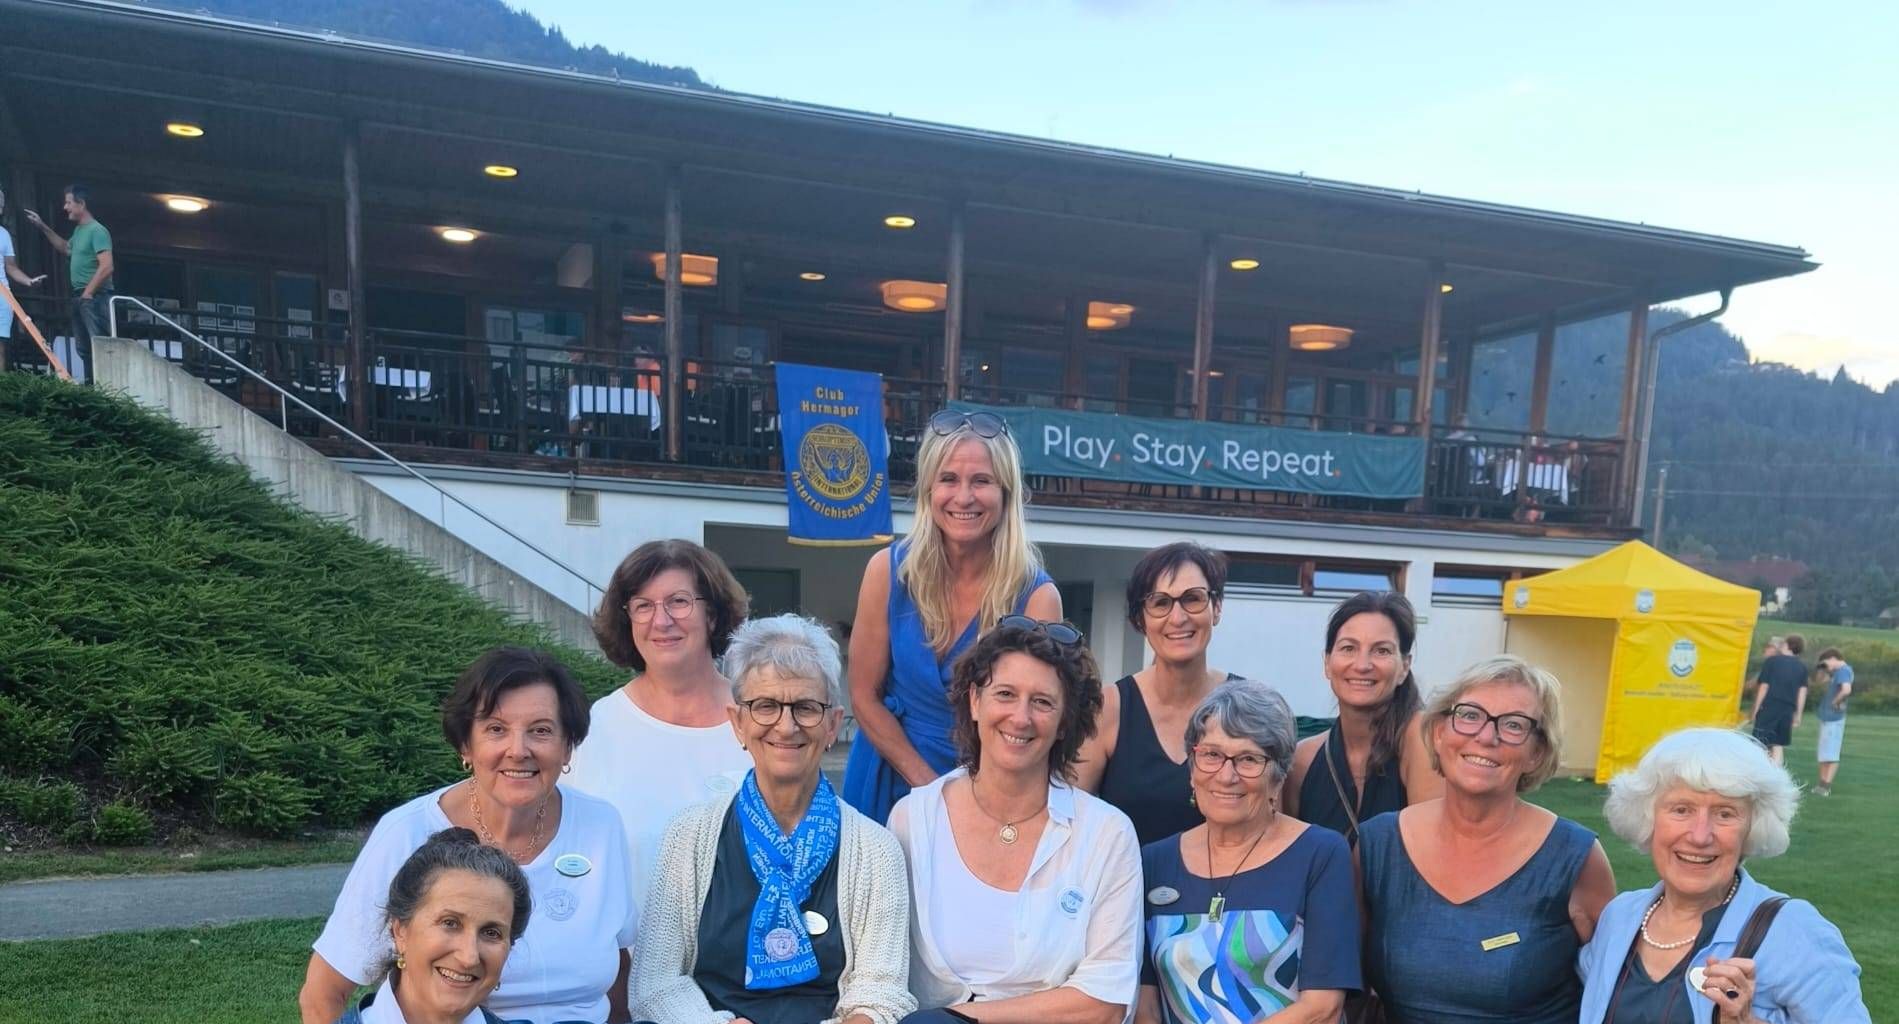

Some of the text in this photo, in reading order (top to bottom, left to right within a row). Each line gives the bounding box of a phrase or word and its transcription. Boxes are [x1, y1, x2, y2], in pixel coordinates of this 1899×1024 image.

[815, 386, 844, 401] Club
[801, 401, 860, 418] Hermagor
[1043, 425, 1342, 479] Play. Stay. Repeat.
[864, 472, 885, 504] Union
